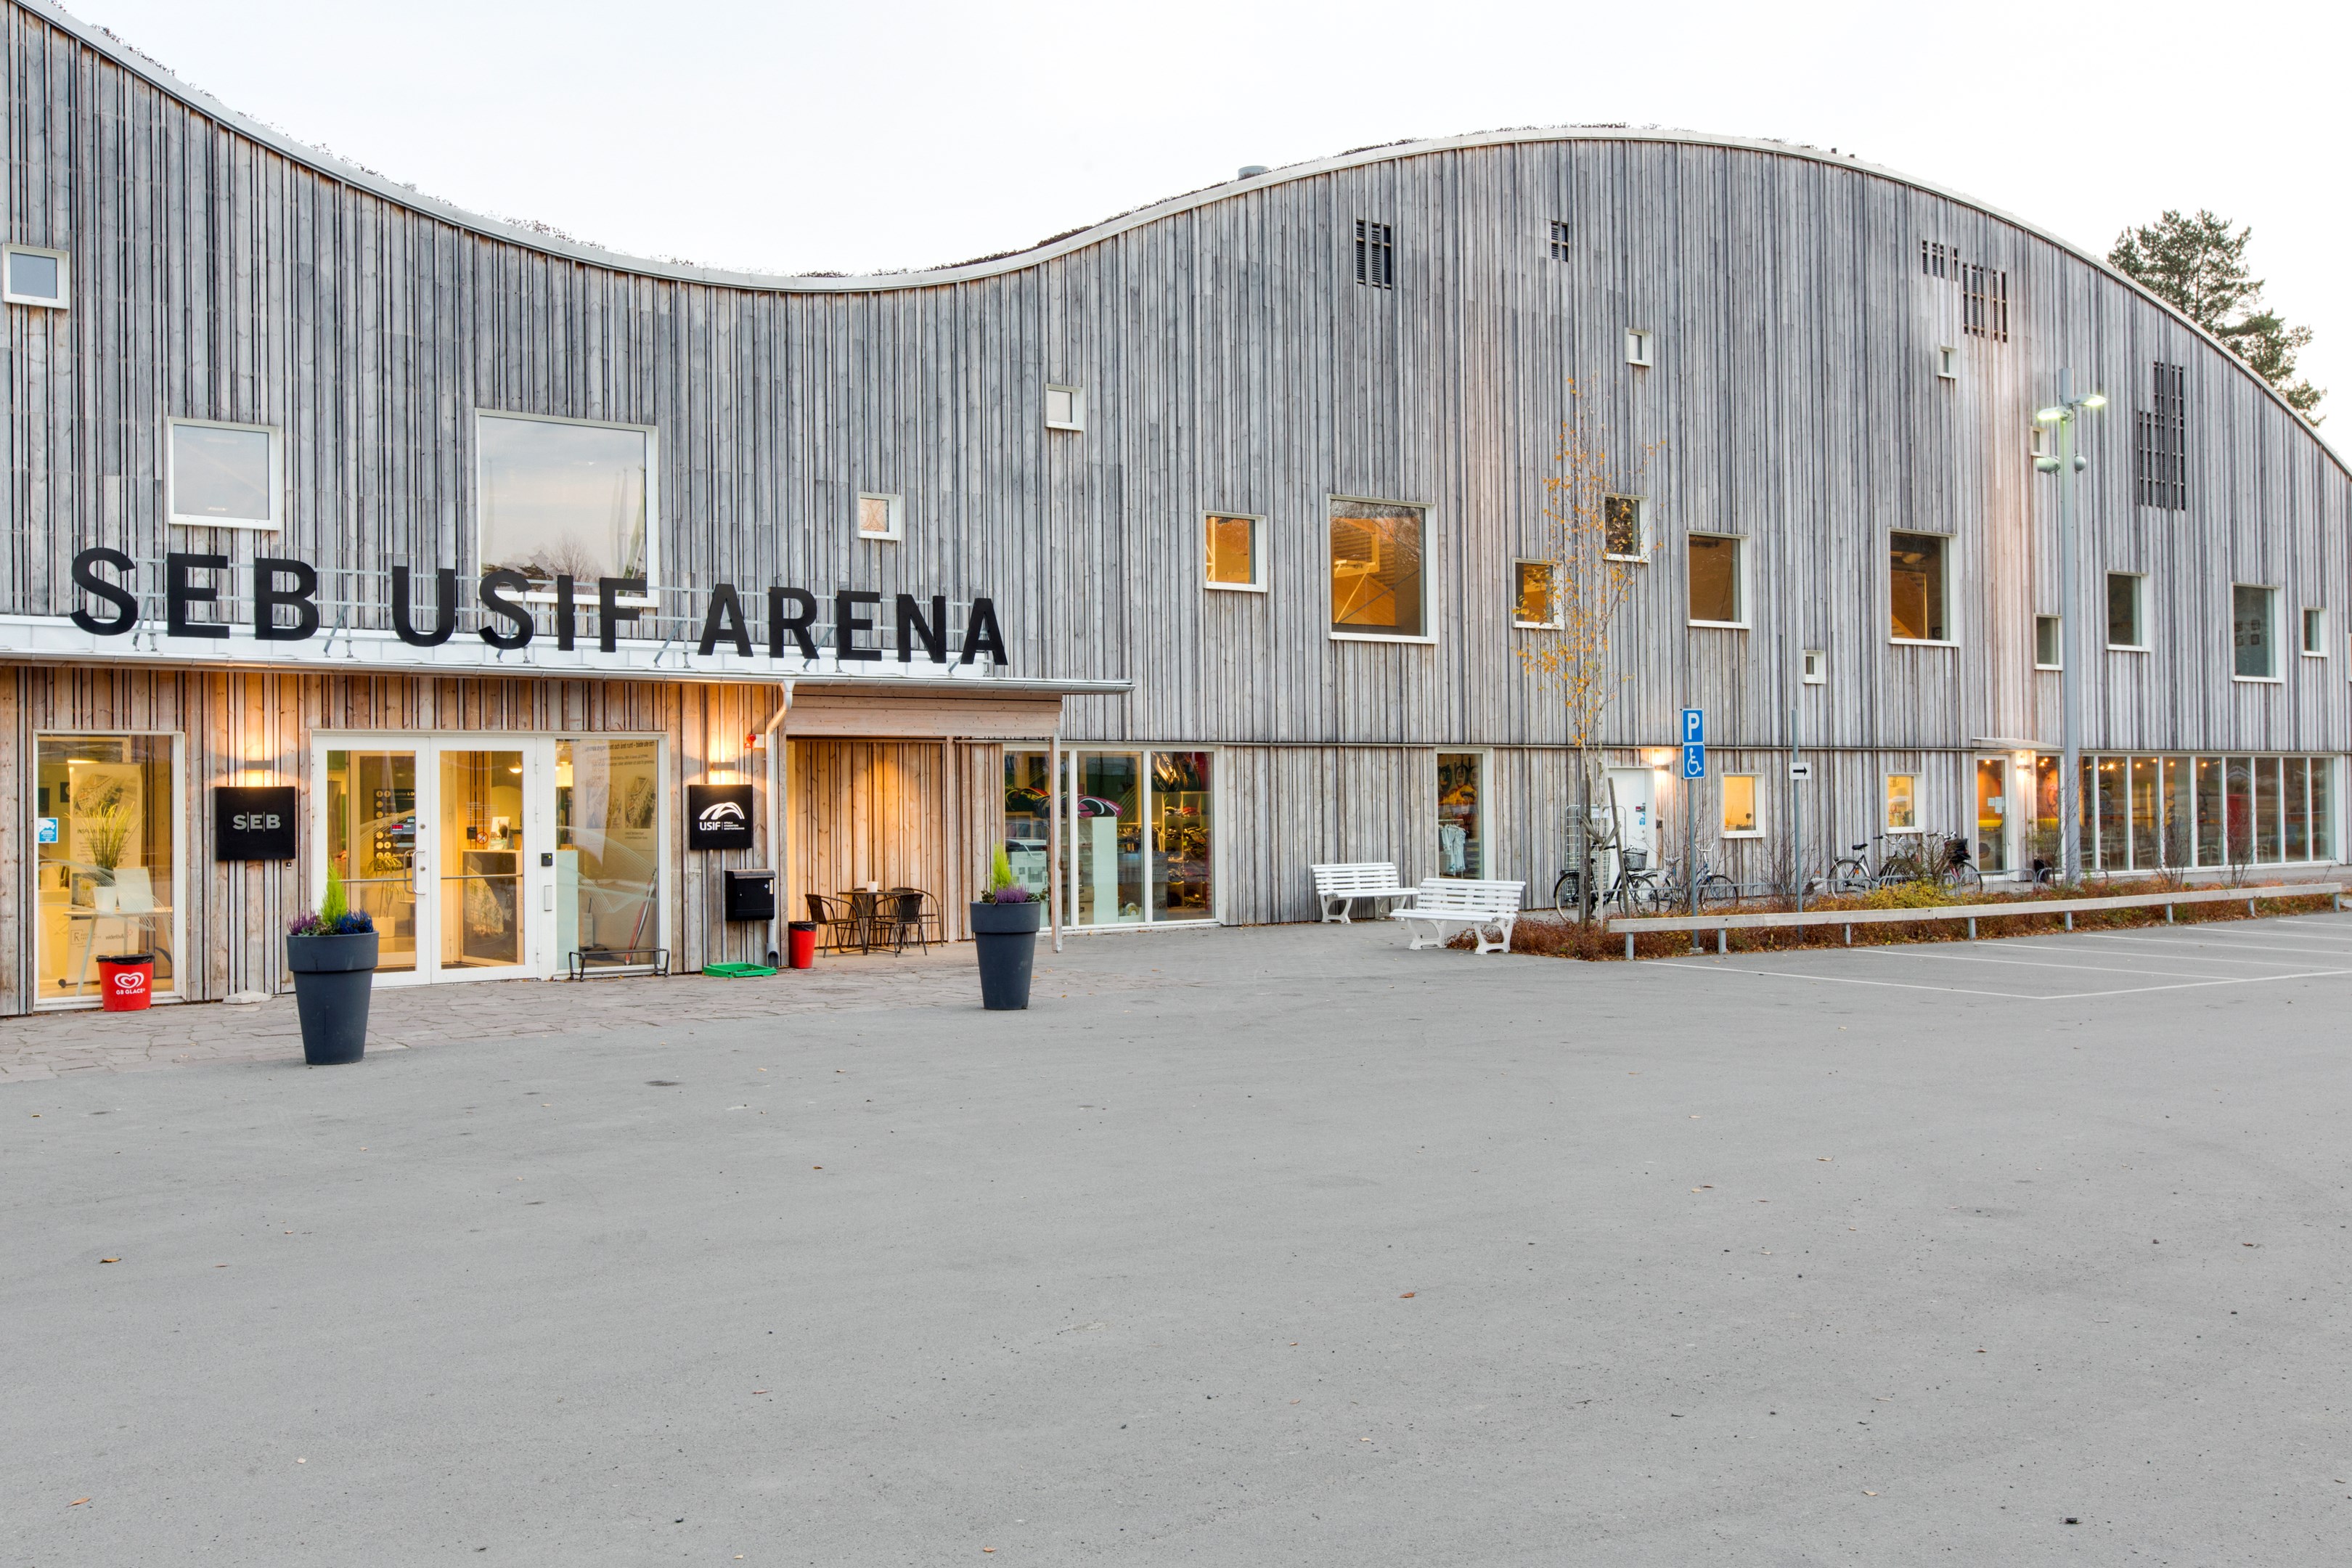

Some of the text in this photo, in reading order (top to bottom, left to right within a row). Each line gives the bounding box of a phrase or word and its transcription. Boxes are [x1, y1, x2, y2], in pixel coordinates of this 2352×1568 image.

[69, 547, 1008, 666] SEB USIF ARENA
[1688, 713, 1700, 740] P
[699, 821, 721, 831] USIF
